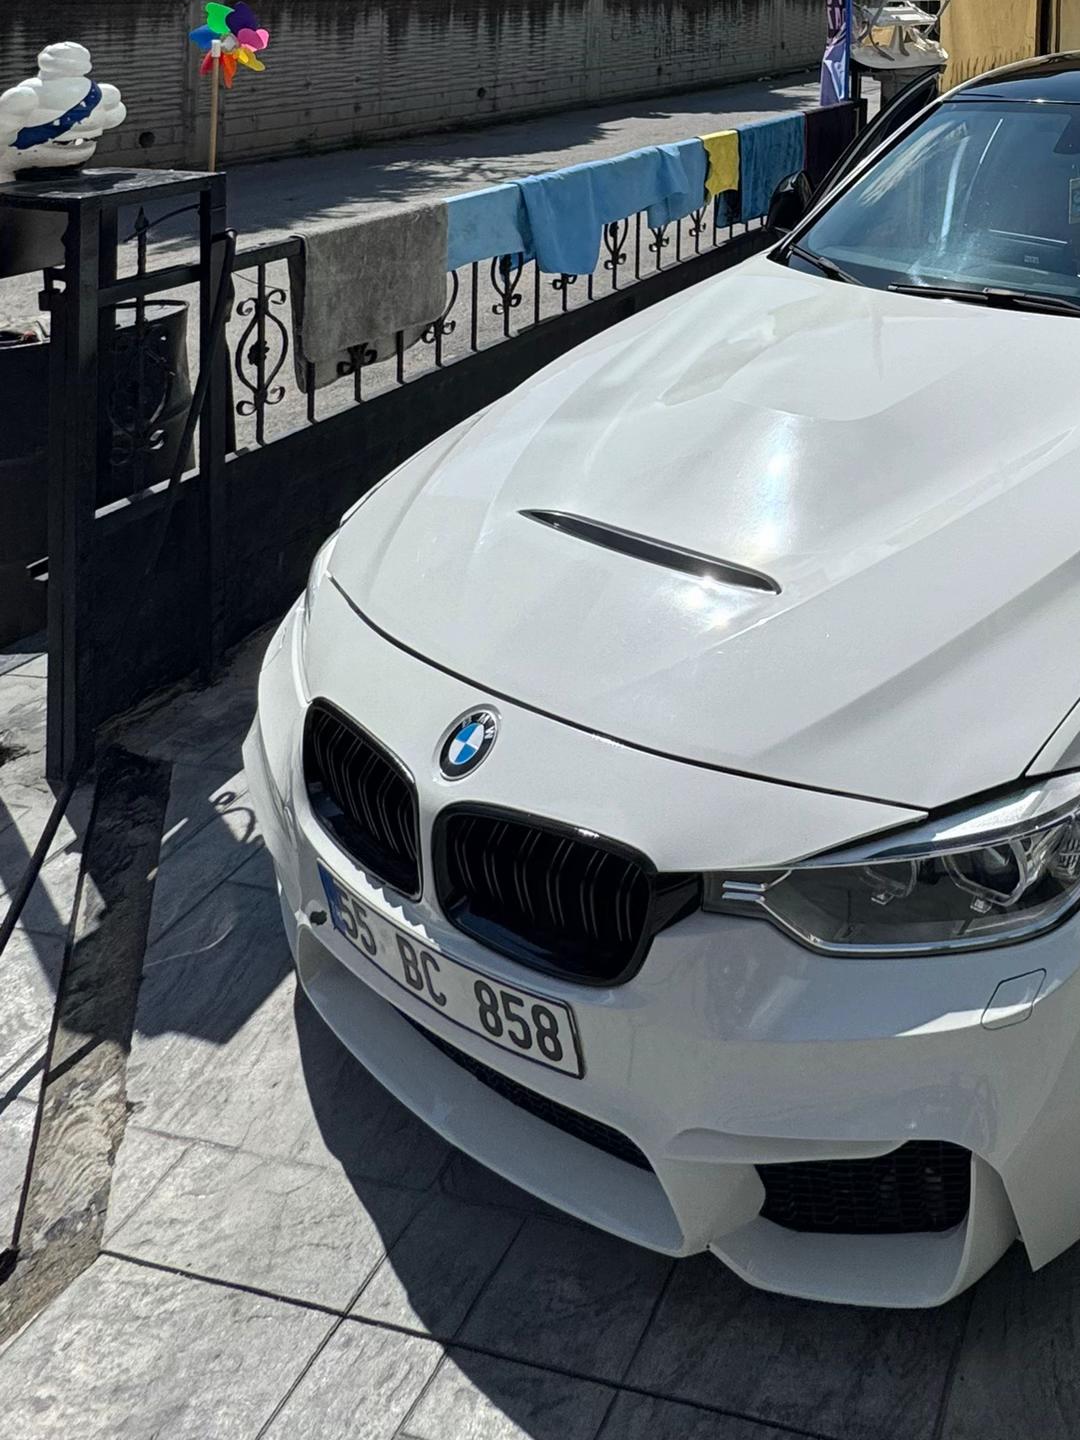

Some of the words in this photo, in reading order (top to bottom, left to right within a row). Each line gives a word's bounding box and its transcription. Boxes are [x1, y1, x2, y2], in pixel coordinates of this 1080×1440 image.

[334, 878, 377, 956] 55
[396, 933, 447, 1007] BC
[474, 980, 563, 1062] 858
